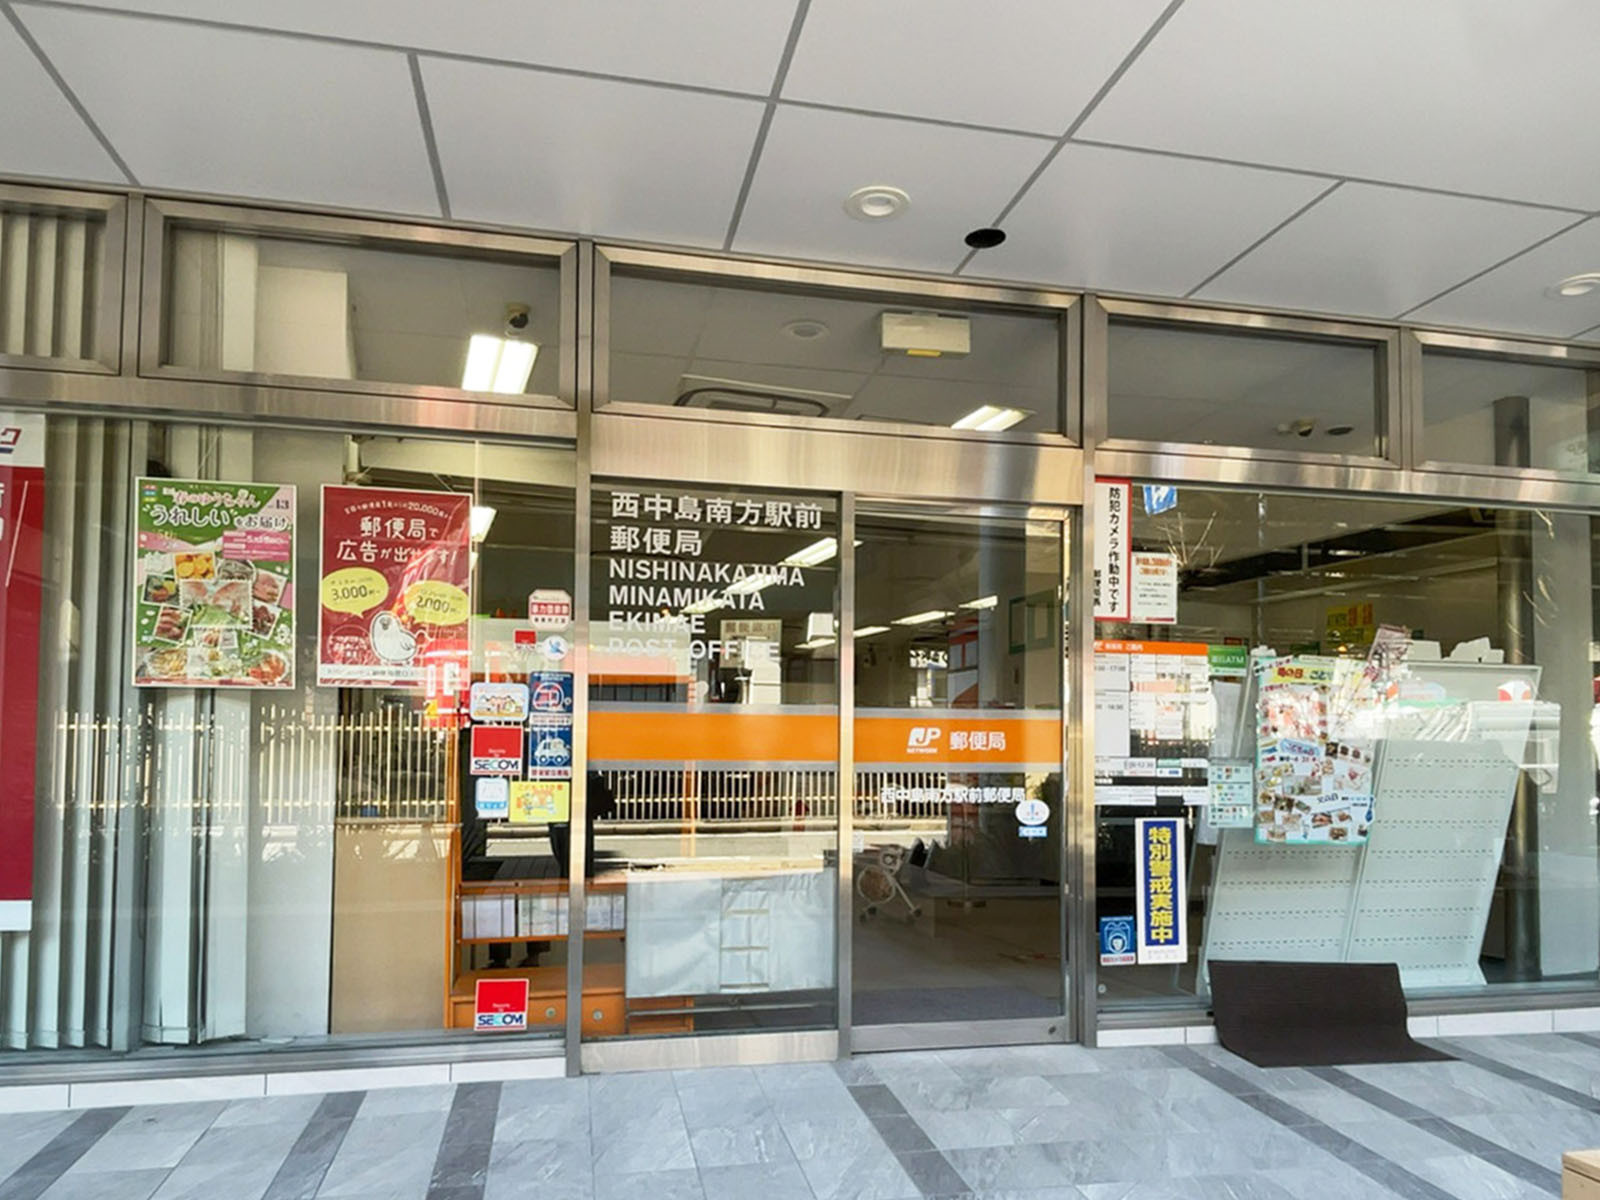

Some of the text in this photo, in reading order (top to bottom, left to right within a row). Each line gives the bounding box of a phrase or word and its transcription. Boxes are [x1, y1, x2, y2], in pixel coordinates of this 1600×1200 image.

[611, 491, 823, 530] 西中島南方駅前
[609, 525, 703, 557] 郵便局
[1108, 487, 1122, 613] 防犯カメラ作動中です
[949, 731, 1006, 751] 郵便局
[474, 759, 519, 771] SECOM
[477, 1014, 523, 1026] SECOM
